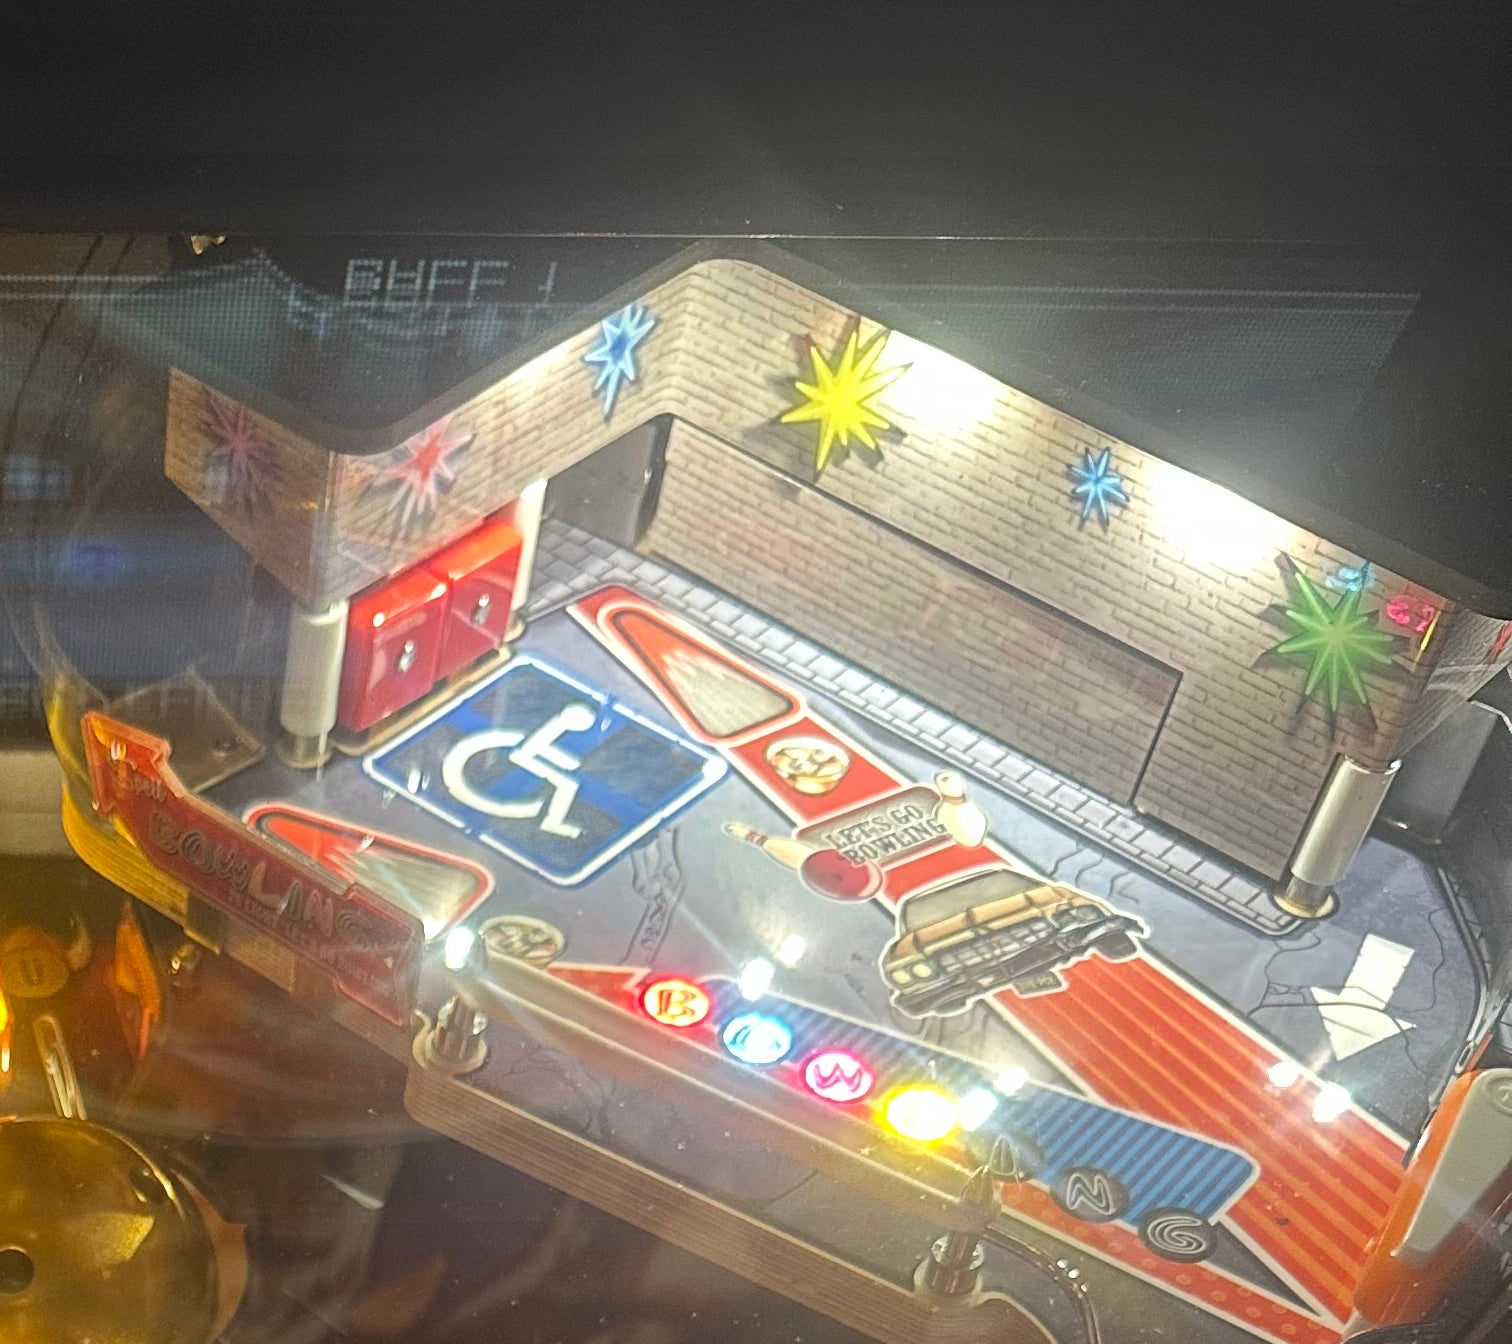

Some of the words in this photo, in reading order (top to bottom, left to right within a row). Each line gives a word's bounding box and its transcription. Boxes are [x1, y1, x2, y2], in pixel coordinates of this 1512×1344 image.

[824, 816, 892, 850] LET'S
[890, 804, 925, 827] GO
[842, 817, 949, 867] BOWLING
